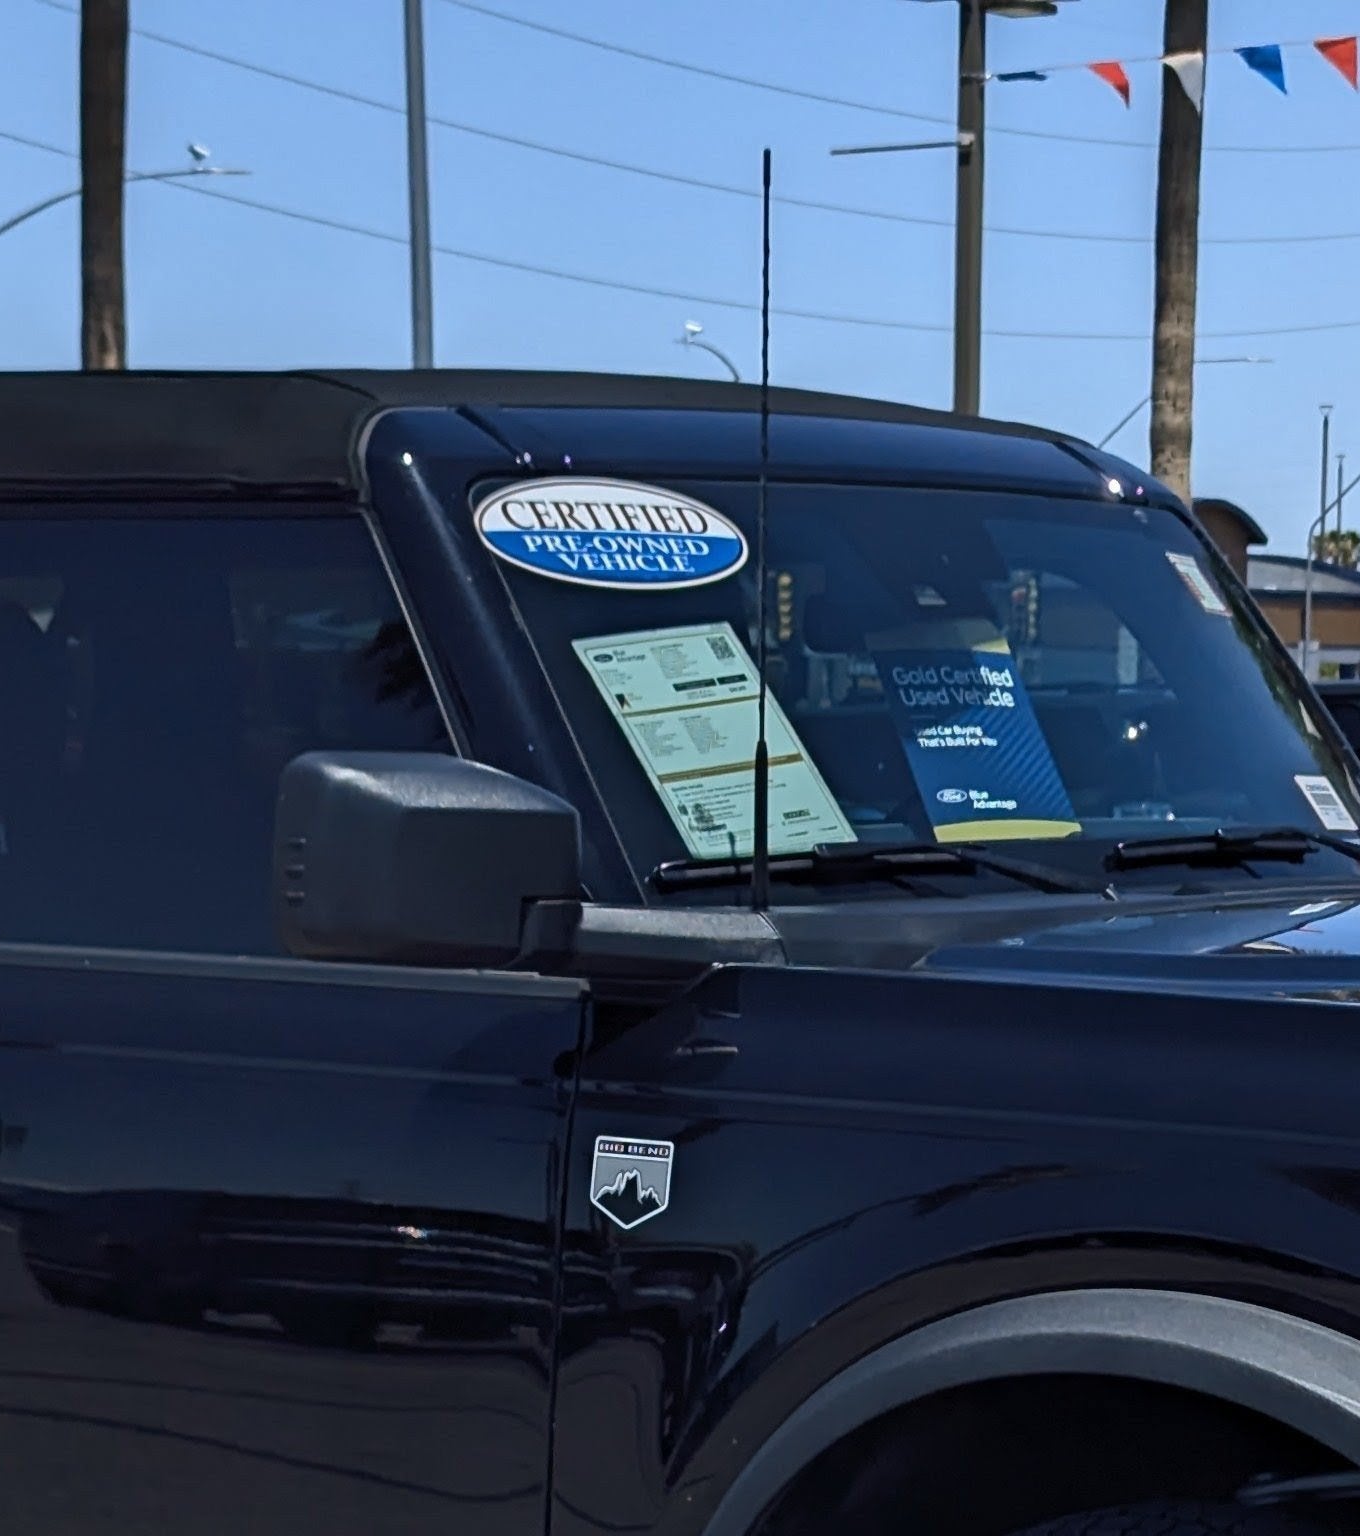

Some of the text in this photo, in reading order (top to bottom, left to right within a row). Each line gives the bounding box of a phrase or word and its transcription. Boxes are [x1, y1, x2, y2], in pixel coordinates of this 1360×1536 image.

[500, 500, 709, 535] CERTIFIED
[521, 534, 710, 556] PRE-OWNED
[557, 552, 695, 573] VEHICLE
[892, 665, 1014, 687] Gold Certified
[899, 687, 1015, 707] Used Vehicle
